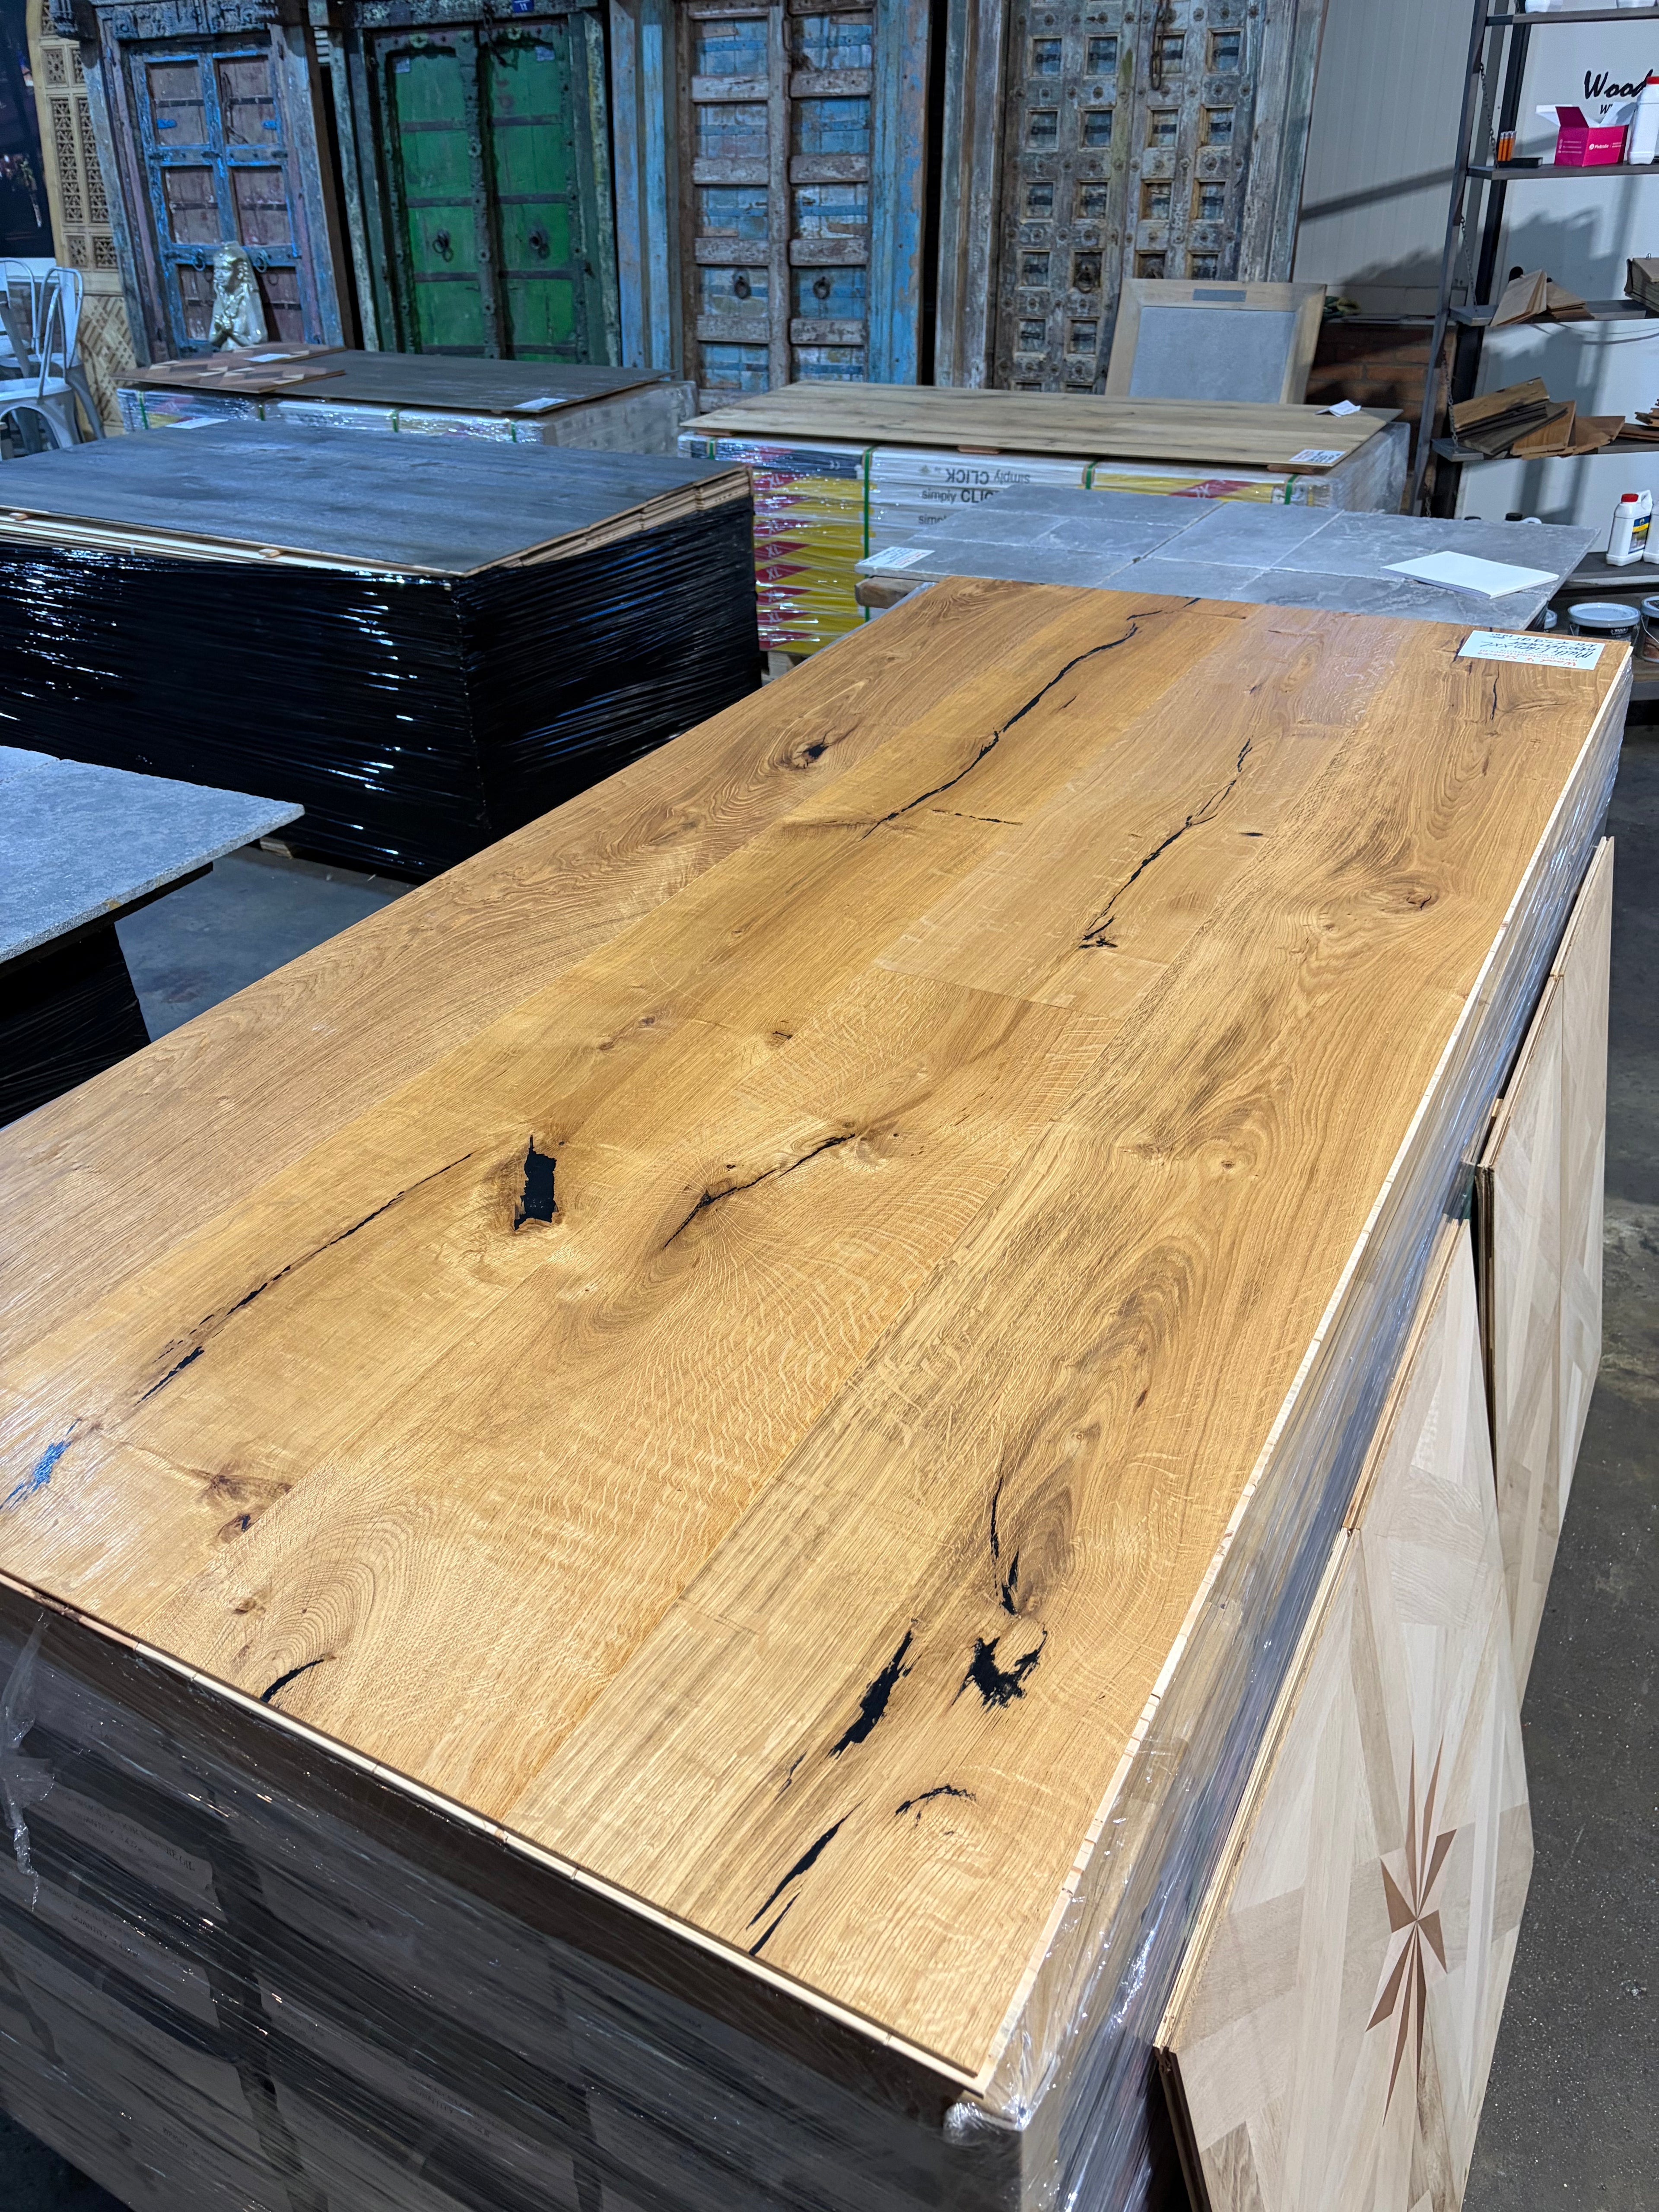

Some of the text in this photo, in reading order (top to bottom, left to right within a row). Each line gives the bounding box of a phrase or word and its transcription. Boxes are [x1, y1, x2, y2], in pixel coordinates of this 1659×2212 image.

[945, 468, 1031, 485] simply CLICK
[921, 488, 1000, 504] simply CLIC
